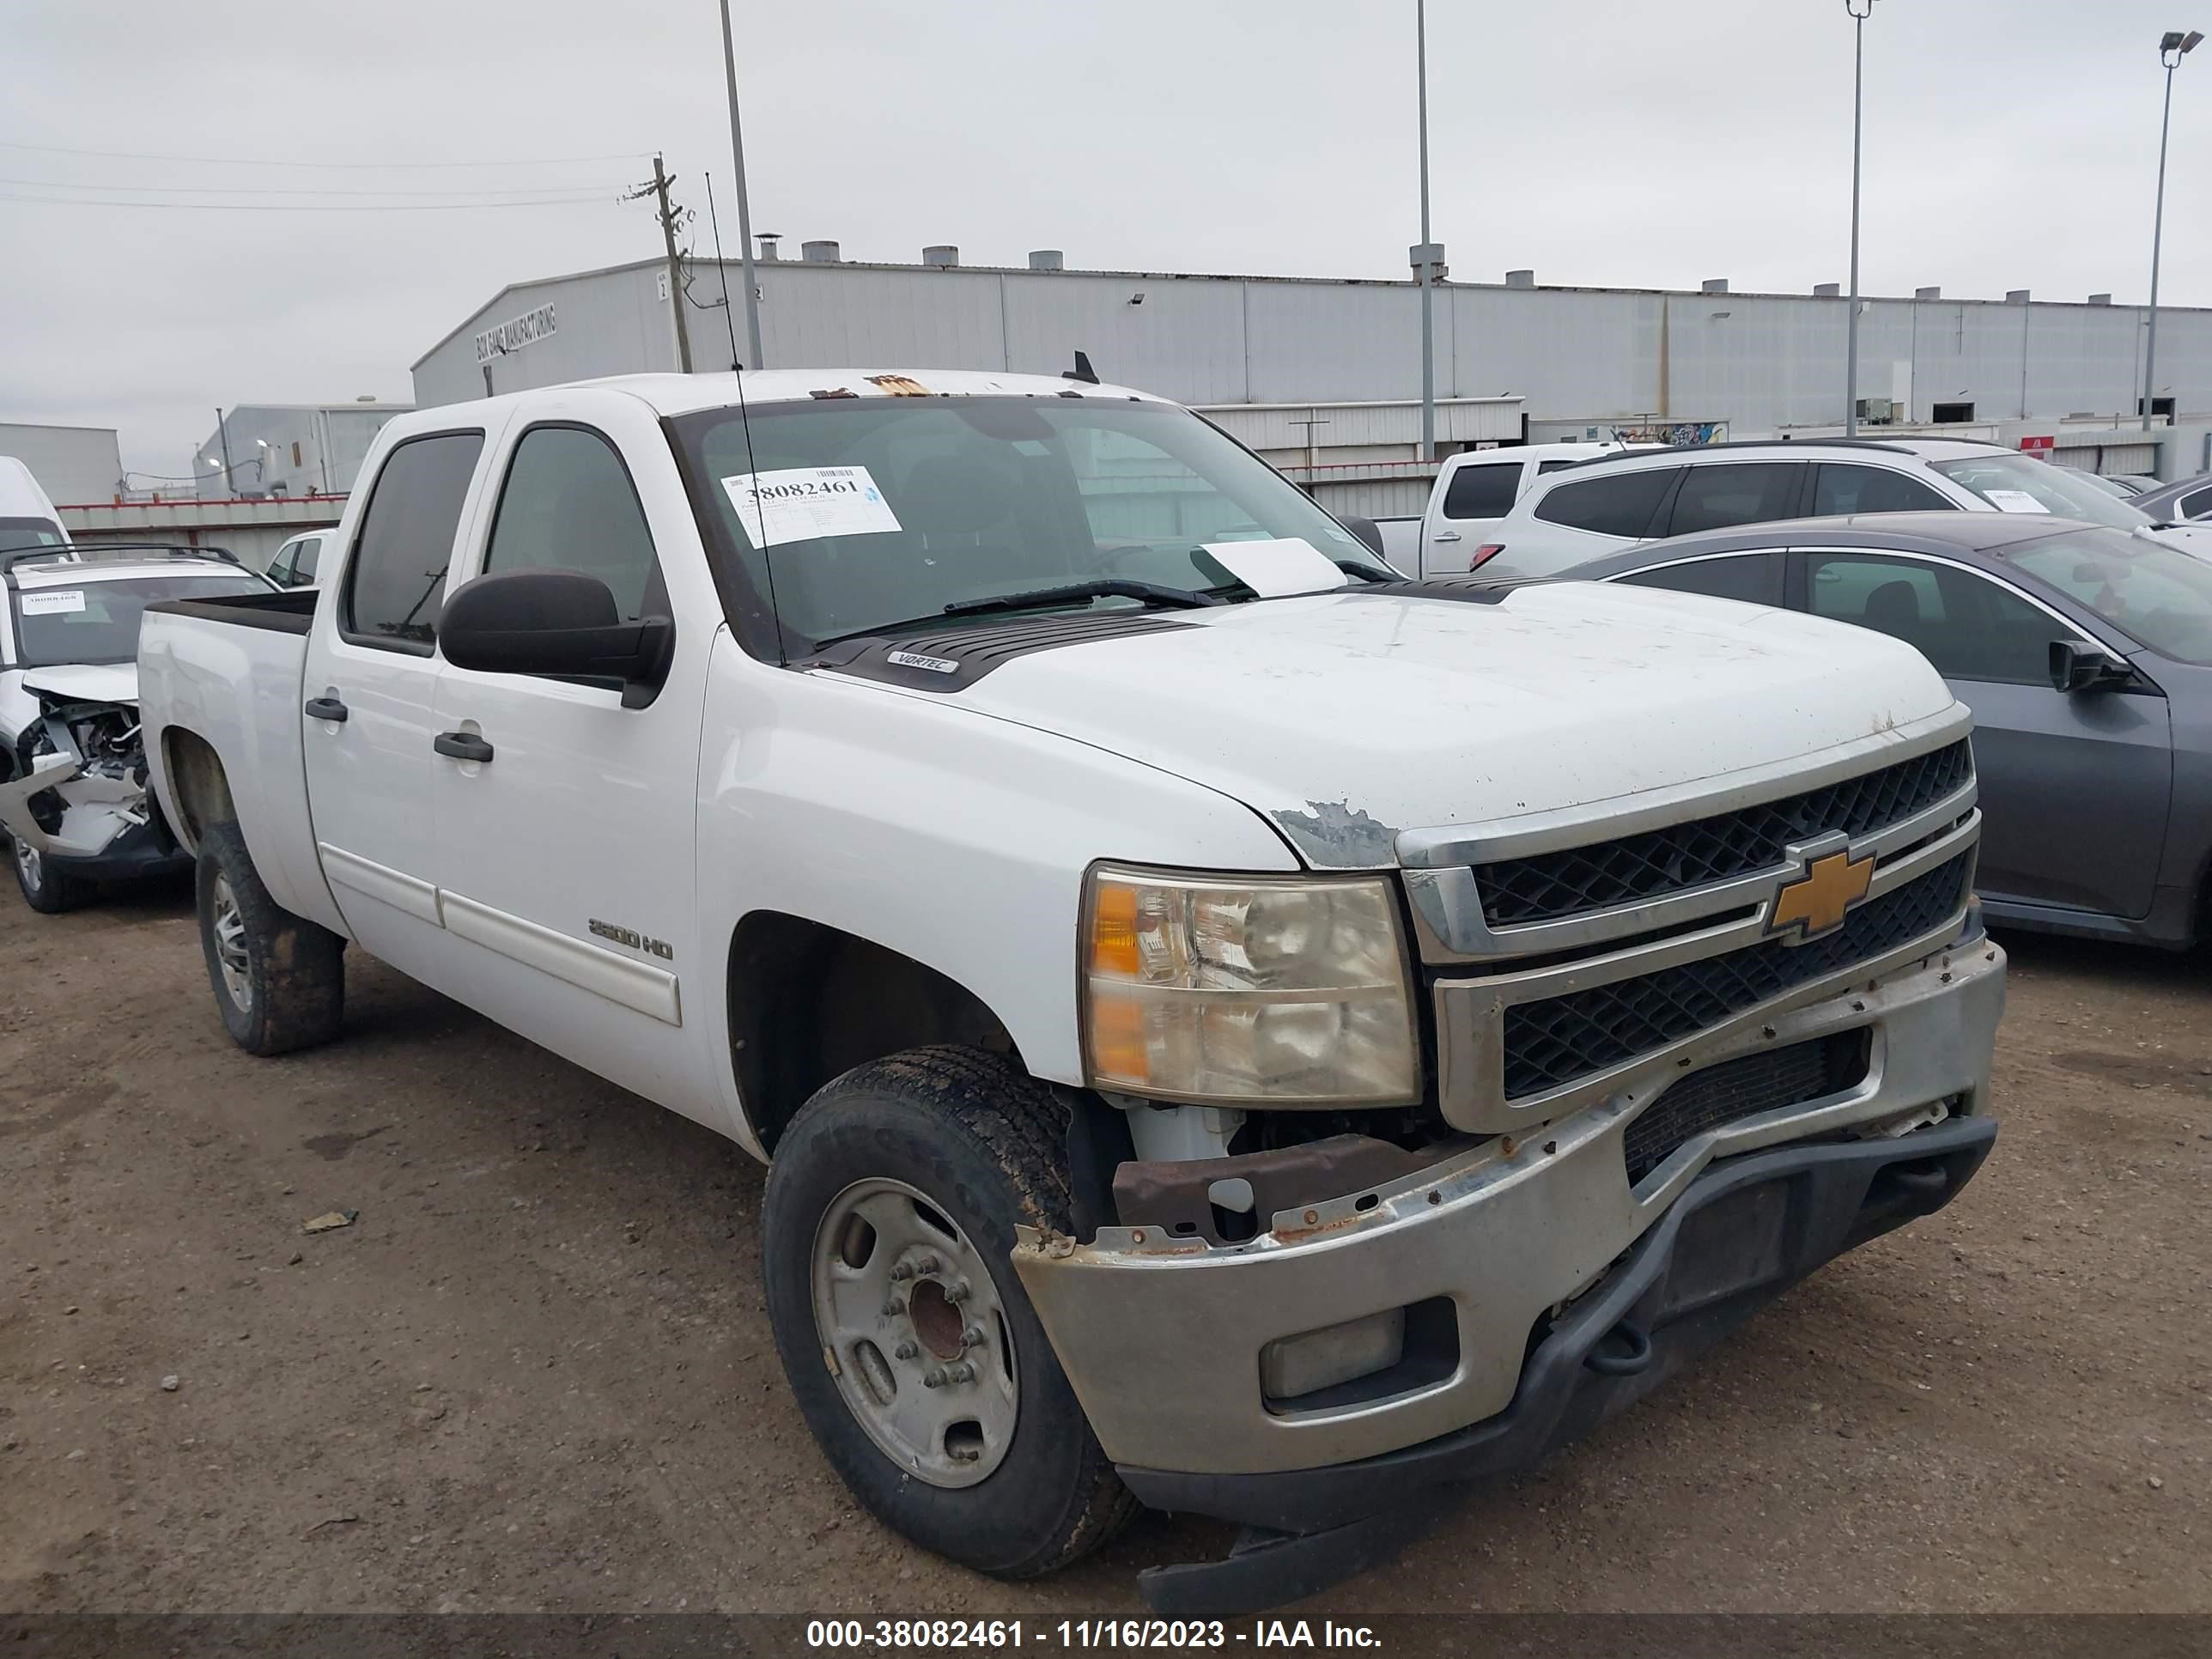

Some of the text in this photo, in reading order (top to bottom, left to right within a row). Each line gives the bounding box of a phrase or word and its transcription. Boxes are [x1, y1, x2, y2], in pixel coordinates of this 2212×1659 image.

[504, 304, 556, 350] MANUFACTURING
[744, 481, 859, 504] 38082461
[898, 653, 948, 670] VORTEC
[588, 918, 673, 961] 2500 HD
